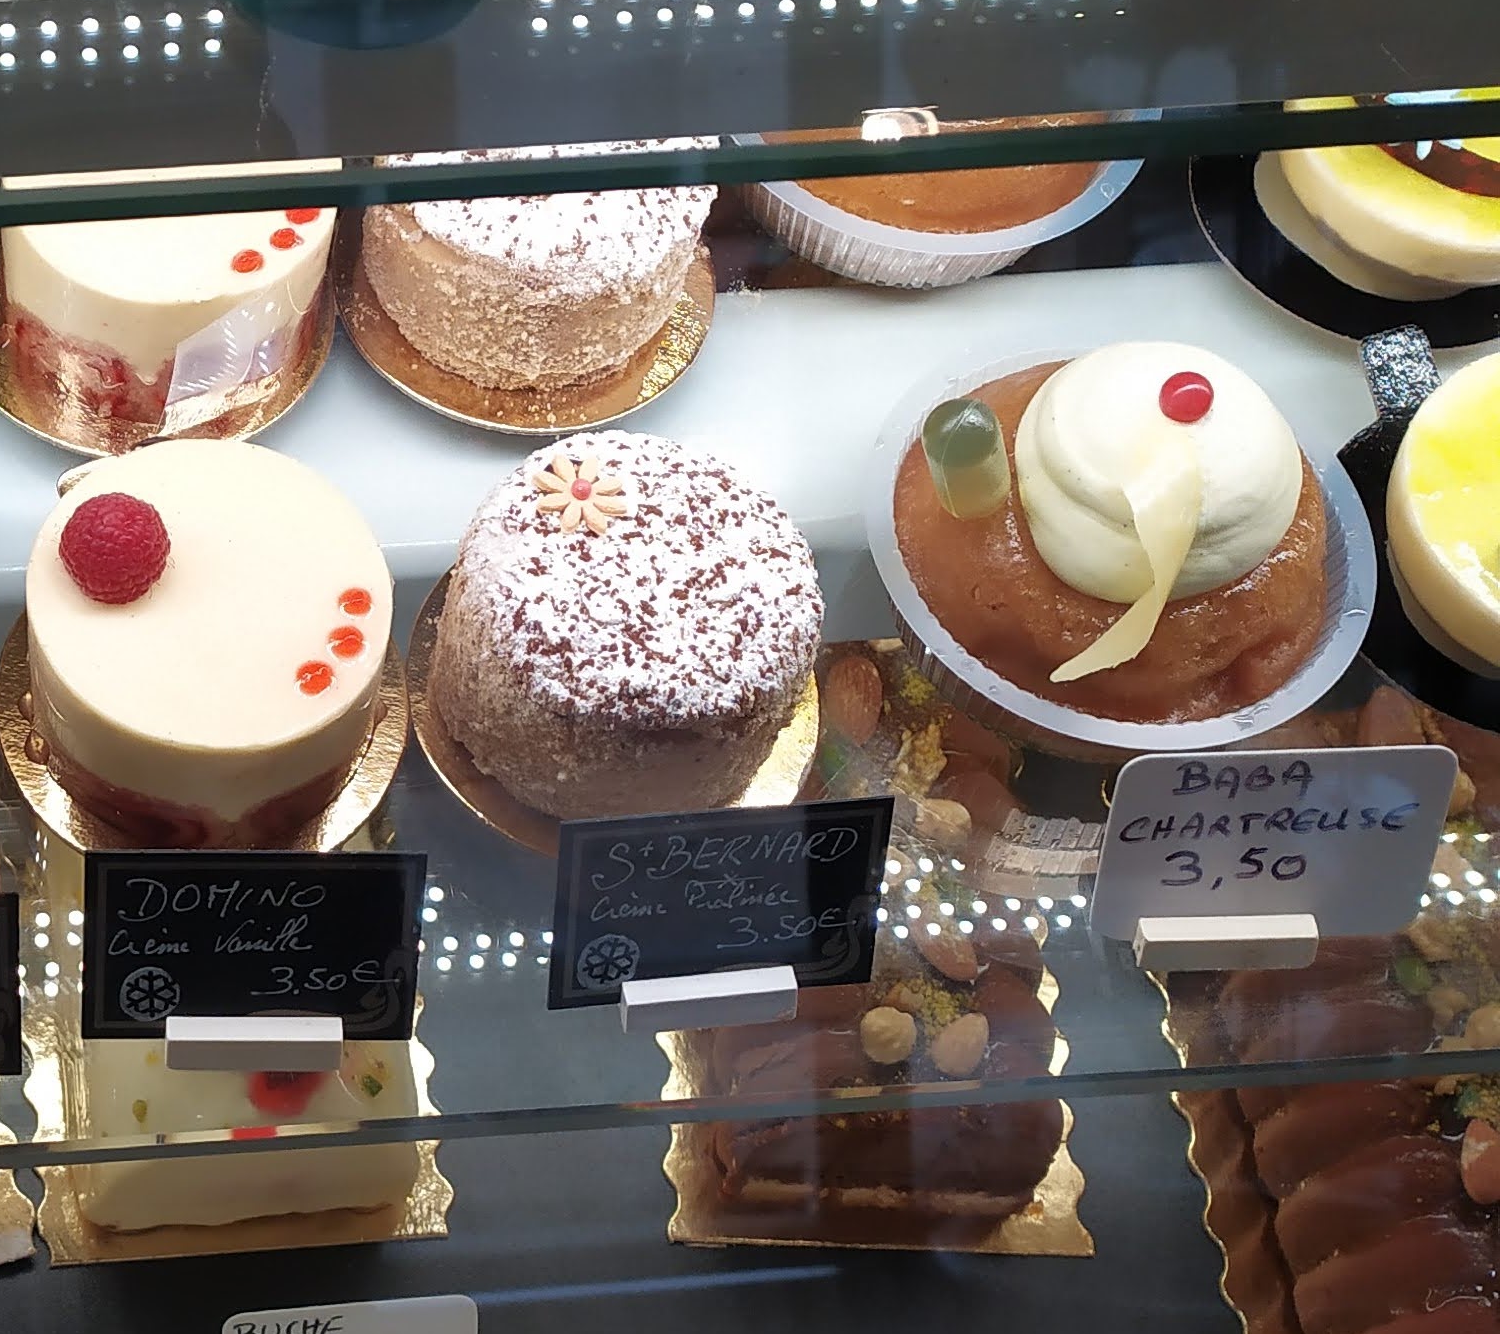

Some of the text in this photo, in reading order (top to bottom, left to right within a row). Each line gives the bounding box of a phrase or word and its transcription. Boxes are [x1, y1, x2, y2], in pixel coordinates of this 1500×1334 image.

[1172, 759, 1316, 799] BABA
[1118, 802, 1420, 844] CHARTREUSE
[648, 827, 859, 880] BERNARD
[1160, 847, 1308, 891] 3,50
[117, 878, 327, 922] DOMINO
[215, 914, 313, 954] Vanille
